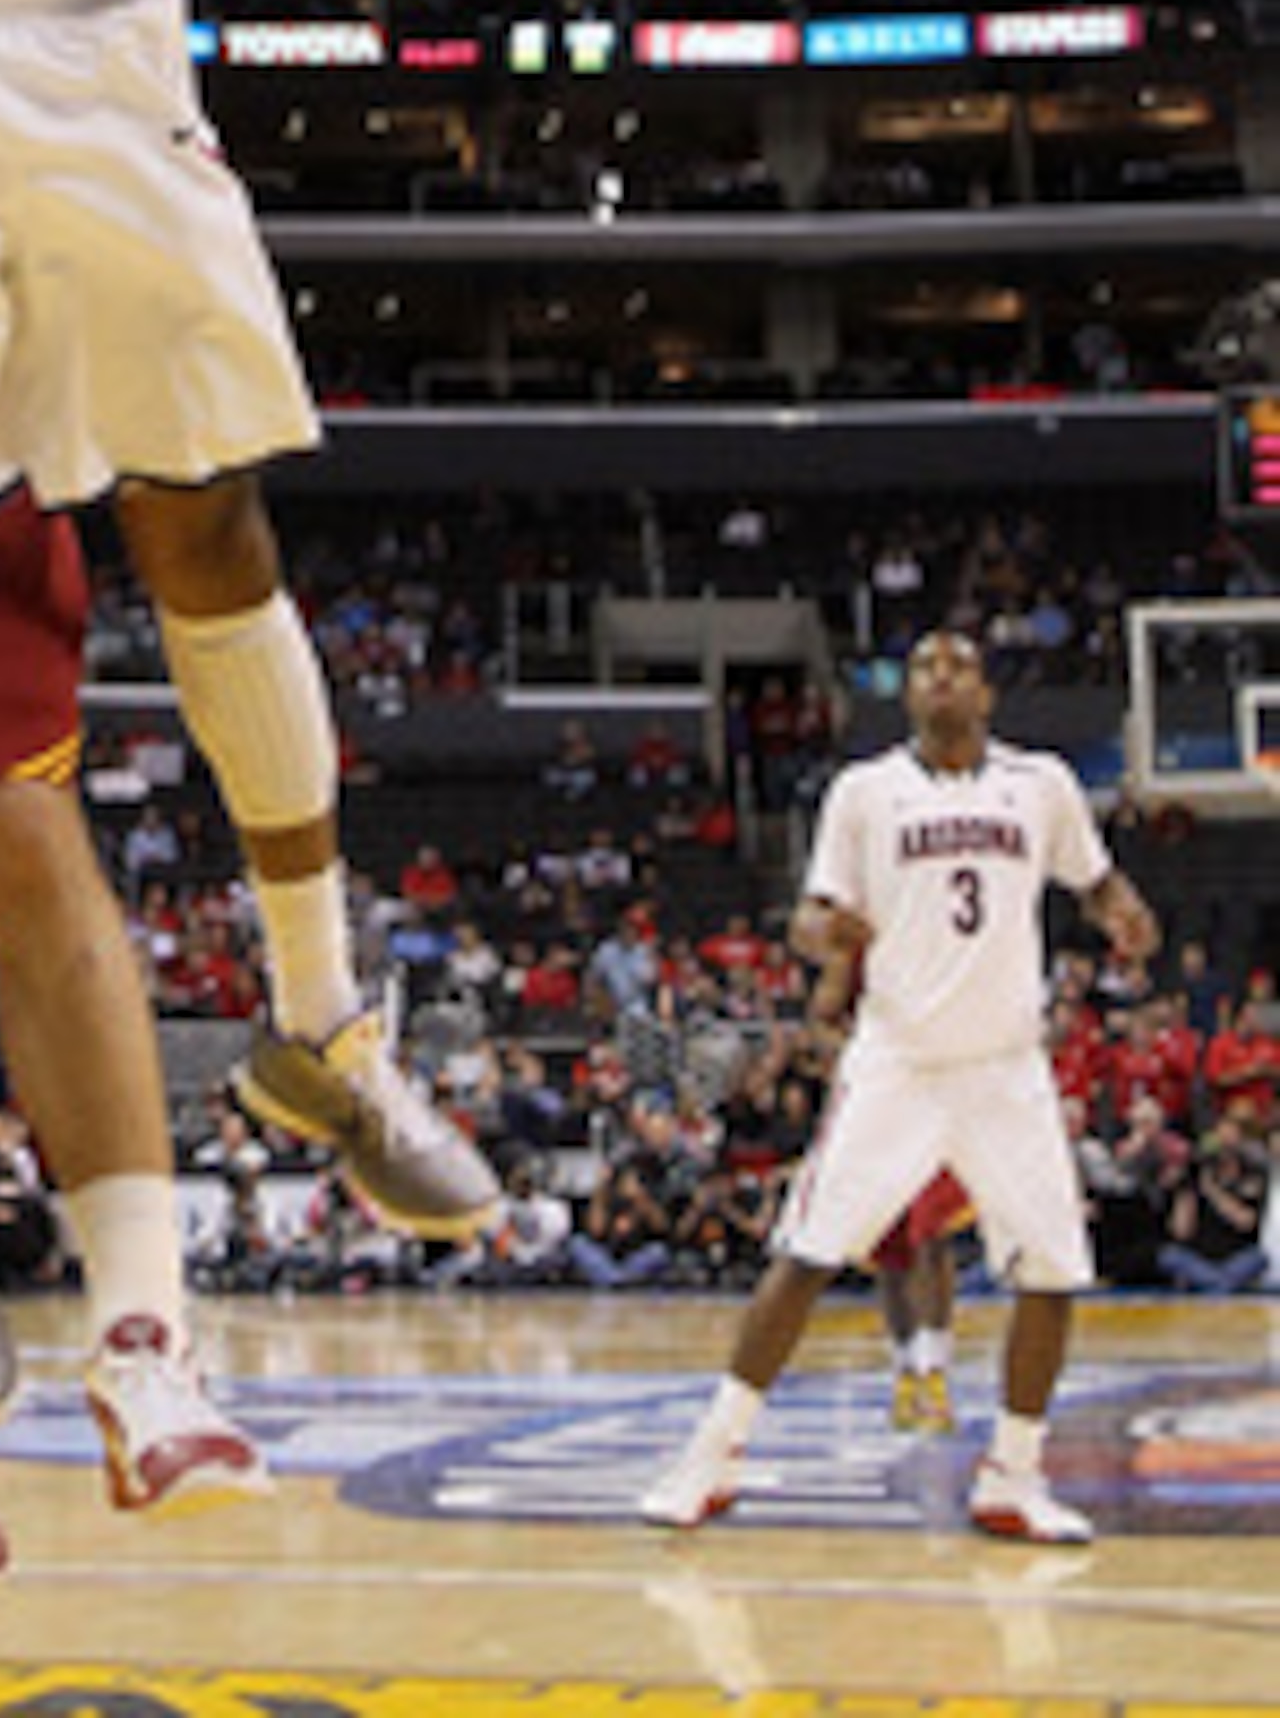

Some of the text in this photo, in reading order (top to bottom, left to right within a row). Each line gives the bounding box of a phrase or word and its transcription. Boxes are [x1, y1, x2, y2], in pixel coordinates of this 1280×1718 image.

[223, 21, 384, 65] TOYOTA
[900, 816, 1026, 860] ARIZONA
[950, 868, 980, 935] 3
